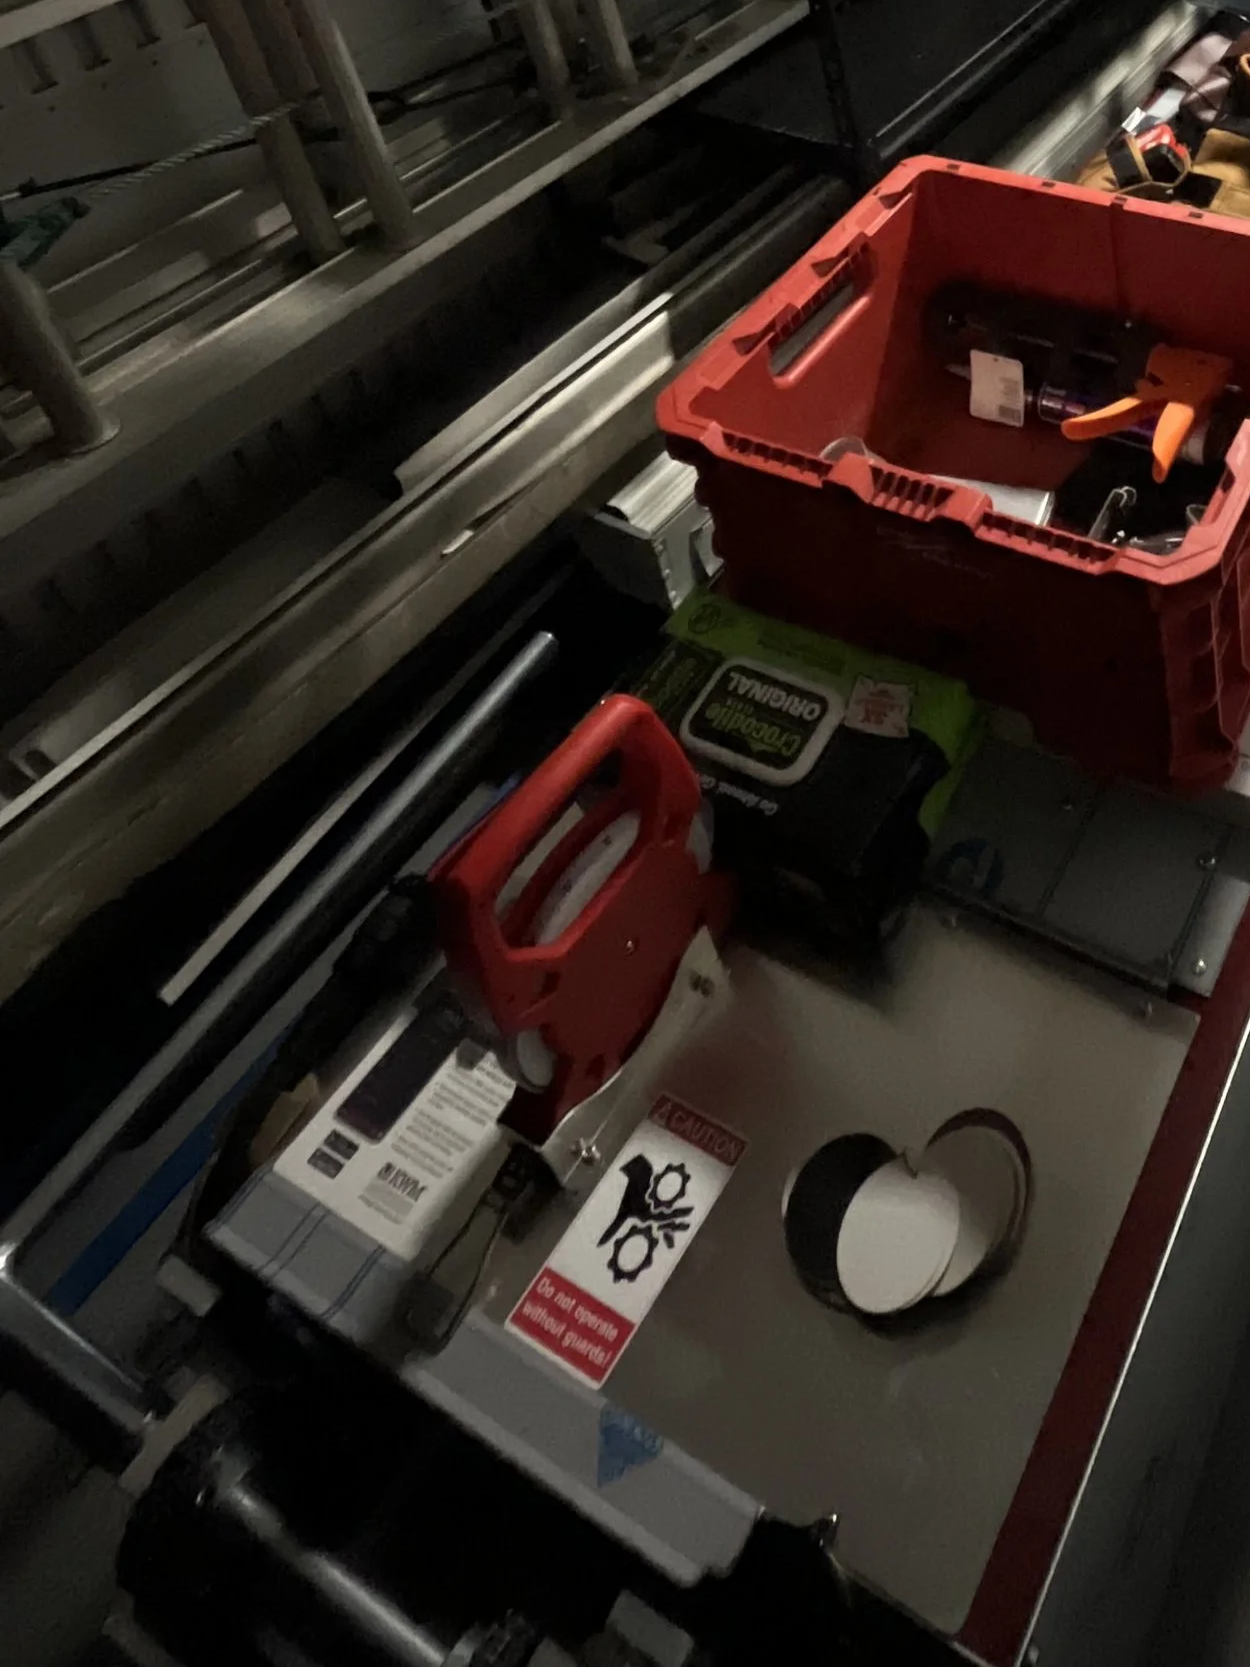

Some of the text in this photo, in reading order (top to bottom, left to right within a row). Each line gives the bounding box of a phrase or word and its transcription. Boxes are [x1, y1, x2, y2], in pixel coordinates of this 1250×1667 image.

[727, 671, 821, 721] ORIGINAL
[669, 1111, 743, 1162] CAUTION
[522, 1300, 613, 1368] without guards!
[536, 1276, 619, 1343] Do not operate
